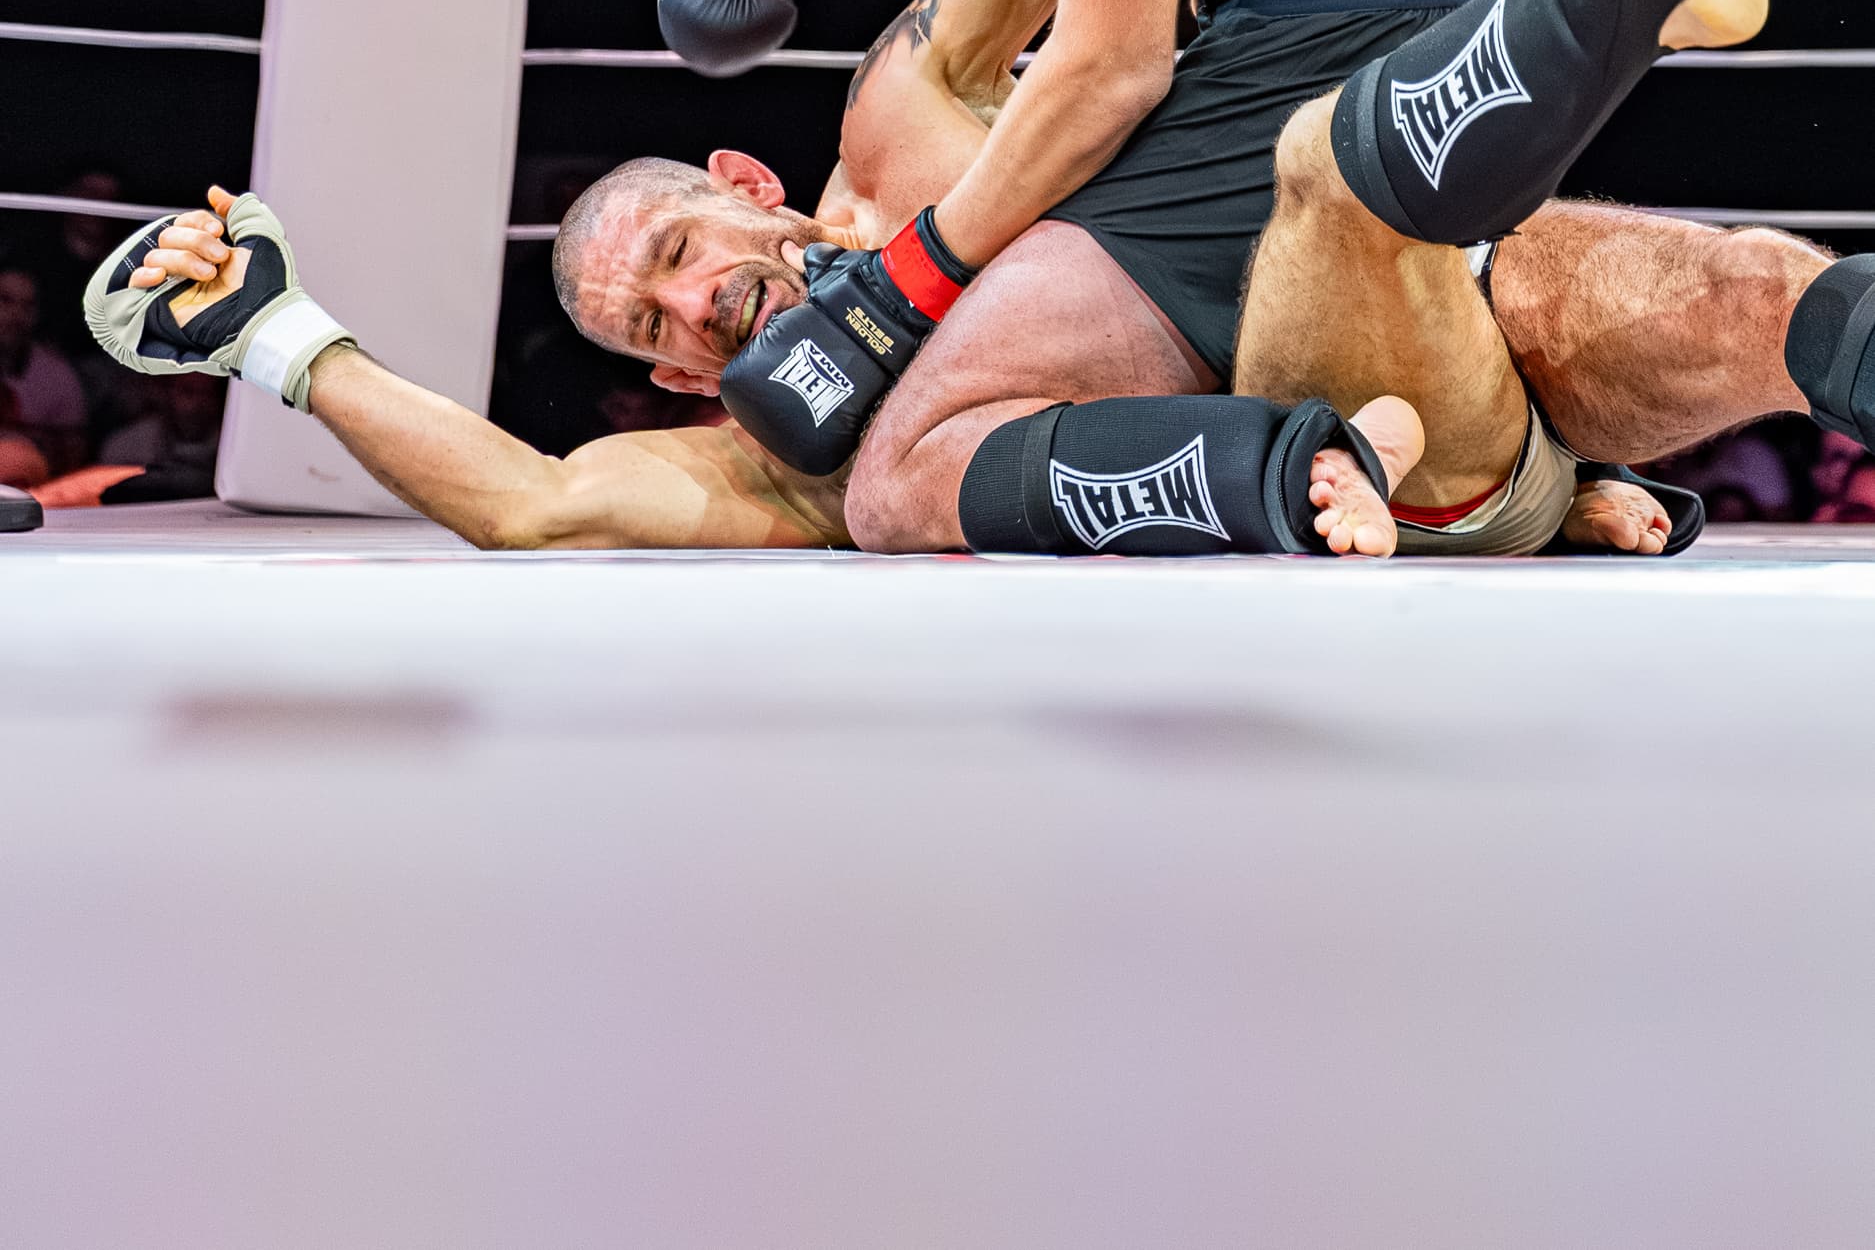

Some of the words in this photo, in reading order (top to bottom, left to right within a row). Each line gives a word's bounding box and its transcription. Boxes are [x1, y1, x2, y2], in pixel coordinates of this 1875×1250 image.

[1397, 18, 1512, 169] METAL
[845, 315, 887, 356] GOLDEN
[853, 306, 895, 347] BELTS
[773, 352, 849, 421] METAL
[809, 348, 851, 389] MMA
[1060, 455, 1210, 542] METAL
